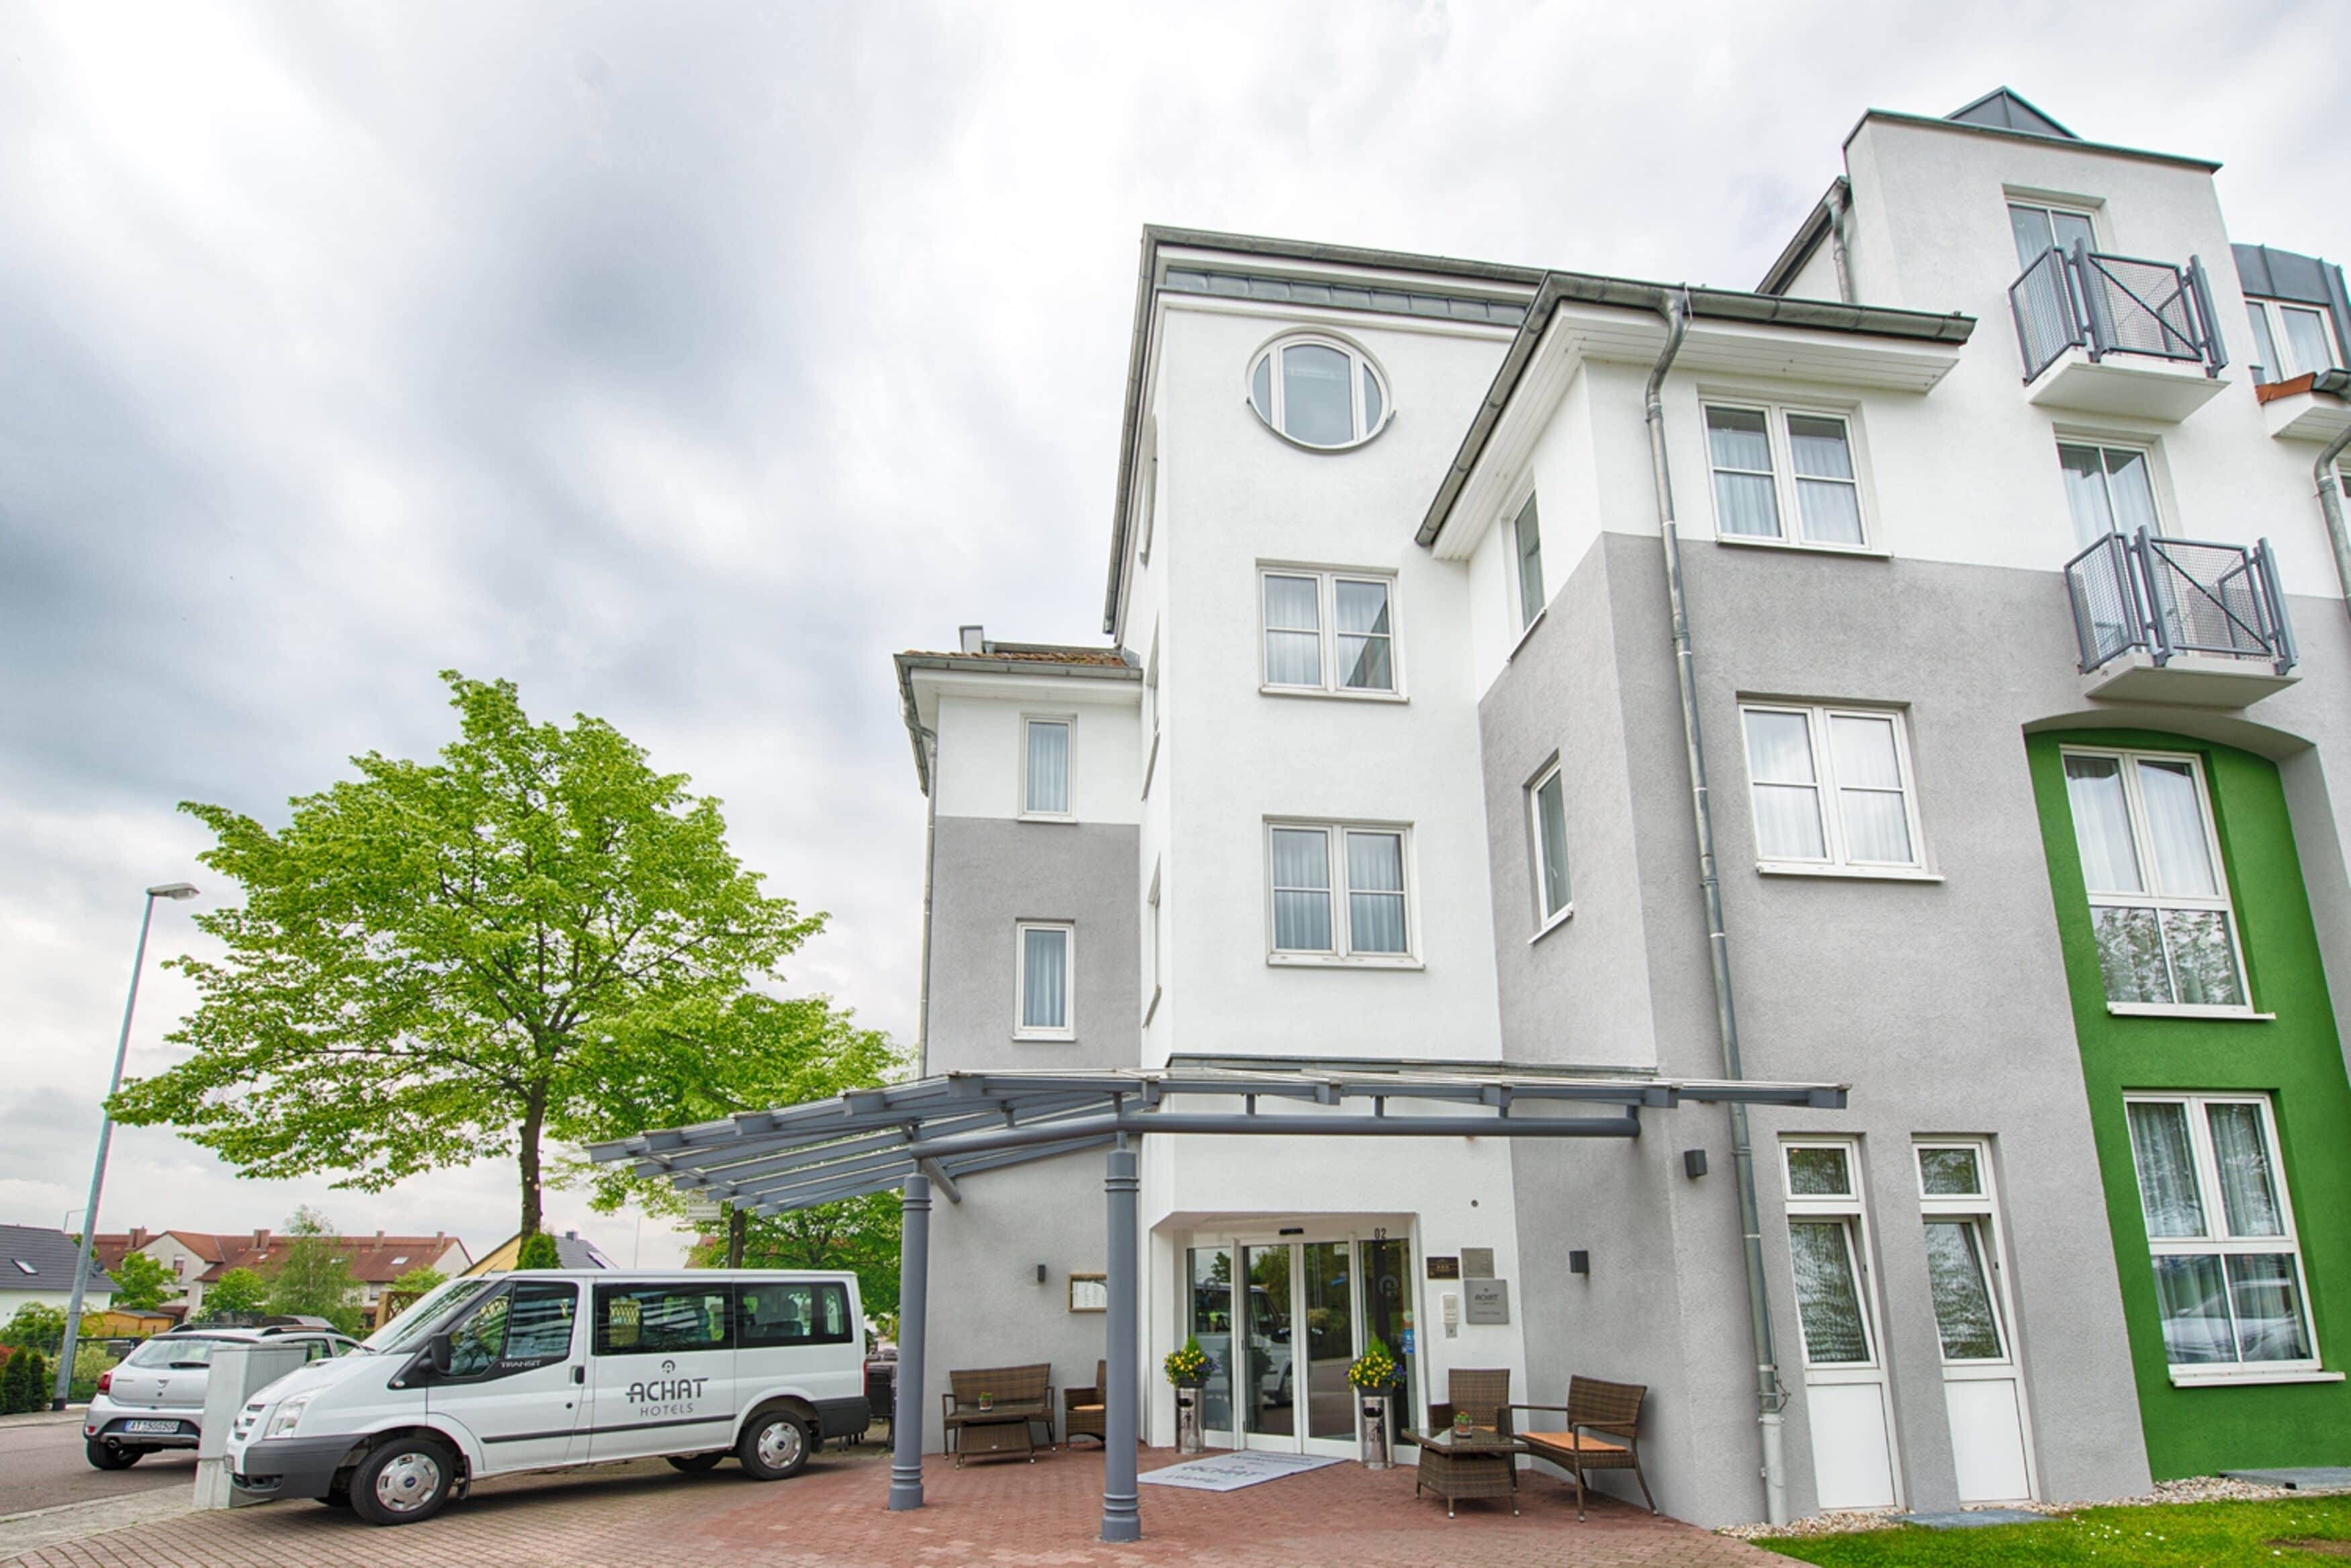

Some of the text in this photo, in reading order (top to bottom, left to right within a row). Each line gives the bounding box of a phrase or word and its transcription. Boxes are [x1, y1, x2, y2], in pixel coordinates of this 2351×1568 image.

[1374, 1228, 1386, 1240] 02
[625, 1377, 709, 1403] ACHAT
[640, 1403, 693, 1417] HOTELS
